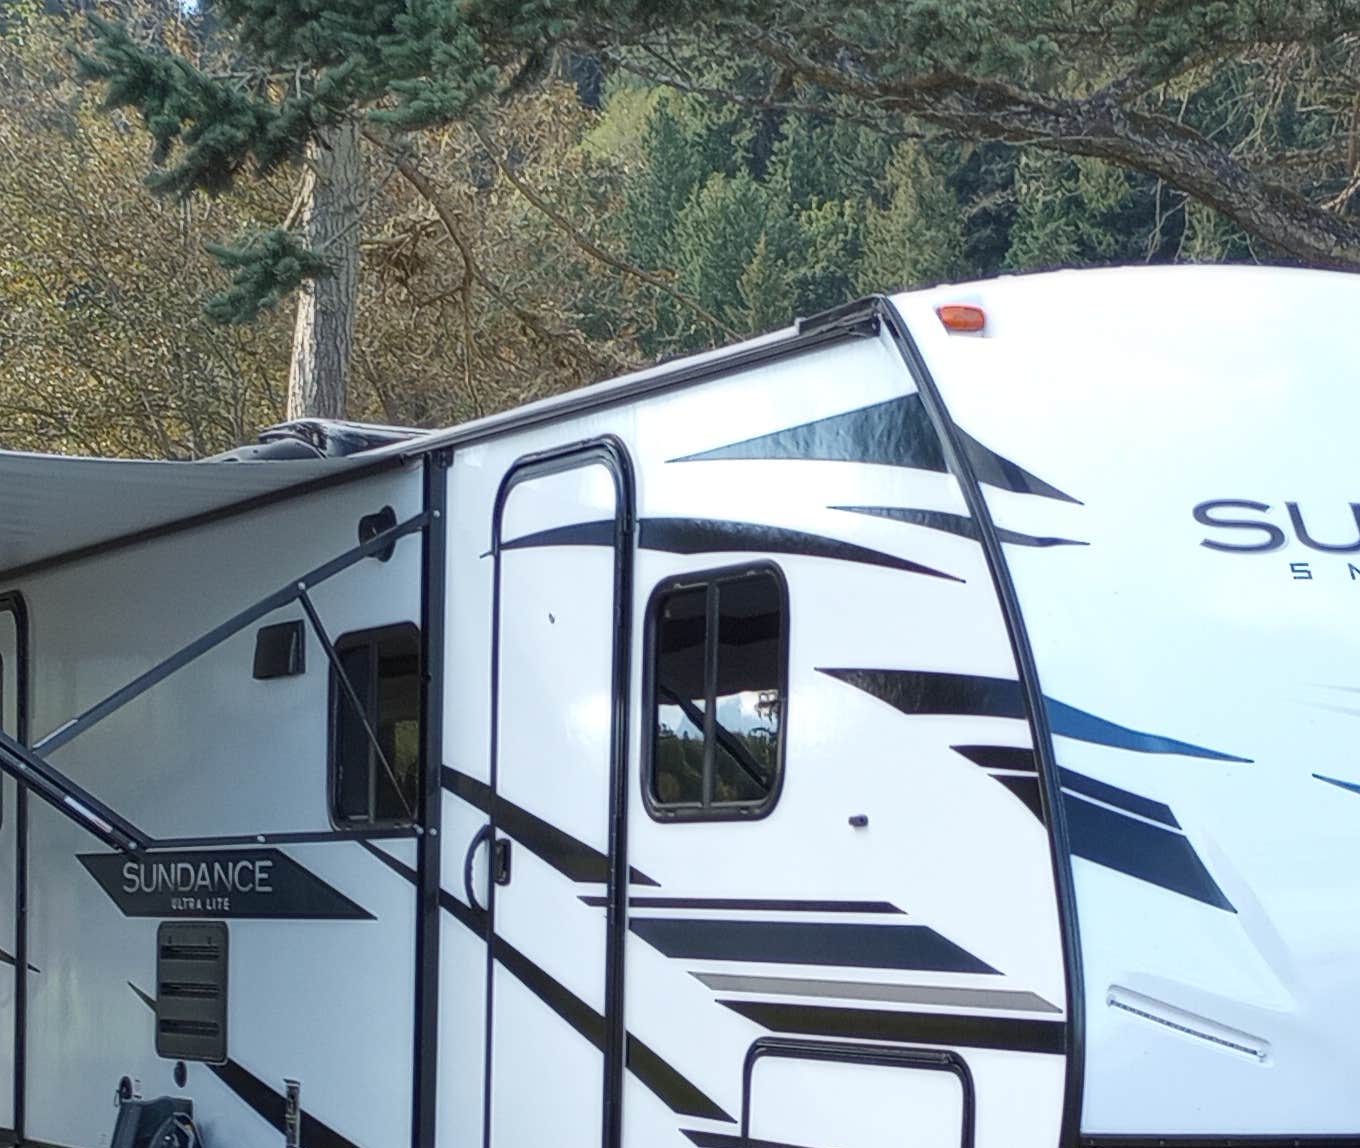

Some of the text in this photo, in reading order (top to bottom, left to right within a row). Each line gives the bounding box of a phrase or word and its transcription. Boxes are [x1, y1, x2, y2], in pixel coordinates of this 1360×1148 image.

[122, 860, 274, 893] SUNDANCE
[171, 897, 230, 911] ULTRA LITE
